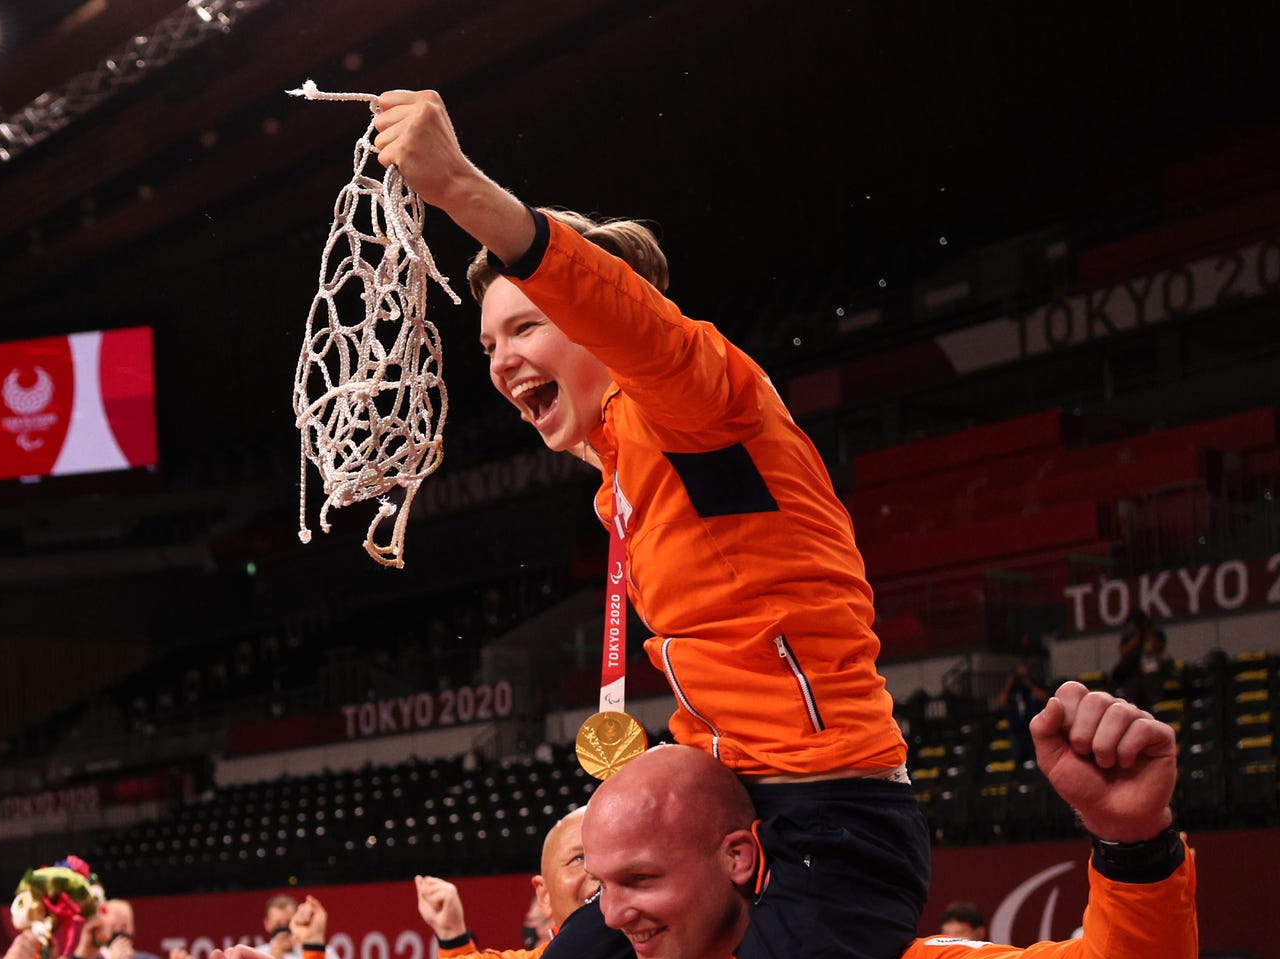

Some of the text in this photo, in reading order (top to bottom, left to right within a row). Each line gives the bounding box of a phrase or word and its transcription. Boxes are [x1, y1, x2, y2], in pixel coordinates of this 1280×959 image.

[1010, 268, 1193, 356] TOKYO
[607, 593, 621, 669] TOKYO 2020
[1063, 560, 1249, 632] TOKYO
[341, 679, 513, 739] TOKYO 2020
